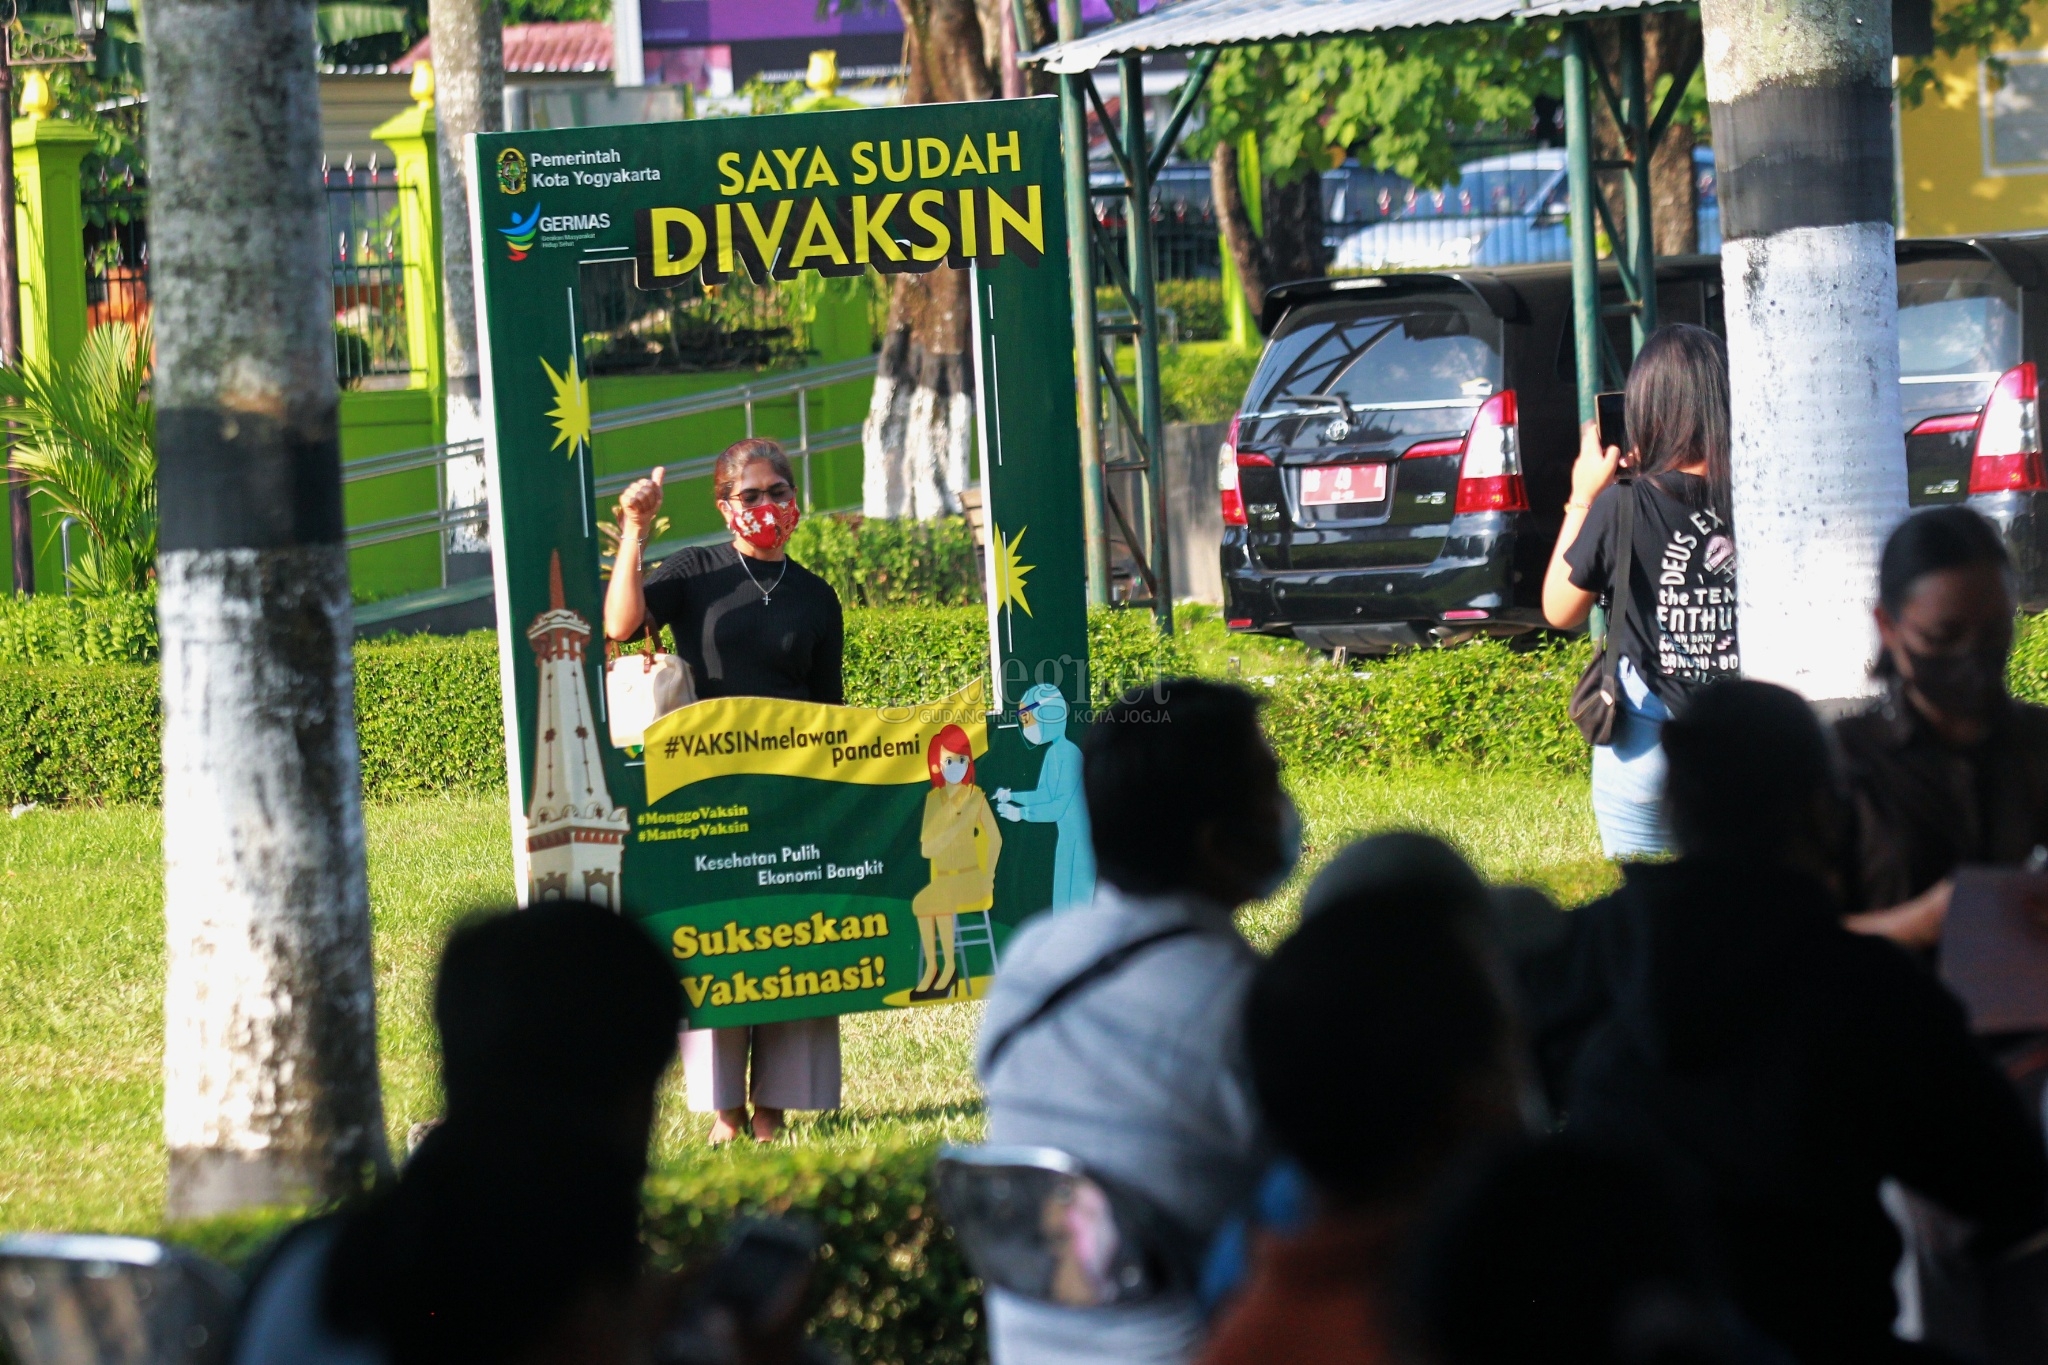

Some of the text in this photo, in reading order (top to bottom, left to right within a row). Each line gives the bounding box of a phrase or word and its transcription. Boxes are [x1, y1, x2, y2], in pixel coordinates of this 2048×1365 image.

[531, 148, 621, 168] Pemerintah
[717, 130, 1021, 196] SAYA SUDAH
[532, 167, 661, 188] Kota Yogyakarta
[539, 213, 611, 232] GERMAS
[650, 184, 1045, 278] DIVAKSIN
[1659, 507, 1726, 586] DEUS EX
[1658, 585, 1690, 606] the
[1656, 606, 1740, 633] ENTHU
[664, 727, 848, 760] #VAKSINmelawan
[831, 734, 921, 768] pandemi
[637, 803, 749, 826] #MonggoVaksin
[637, 820, 749, 842] #MantepVaksin
[695, 844, 820, 872] Kesehatan Pulih
[758, 860, 884, 886] Ekonomi Bangkit
[672, 911, 889, 960] Sukseskan
[679, 956, 886, 1009] Vaksinasi!
